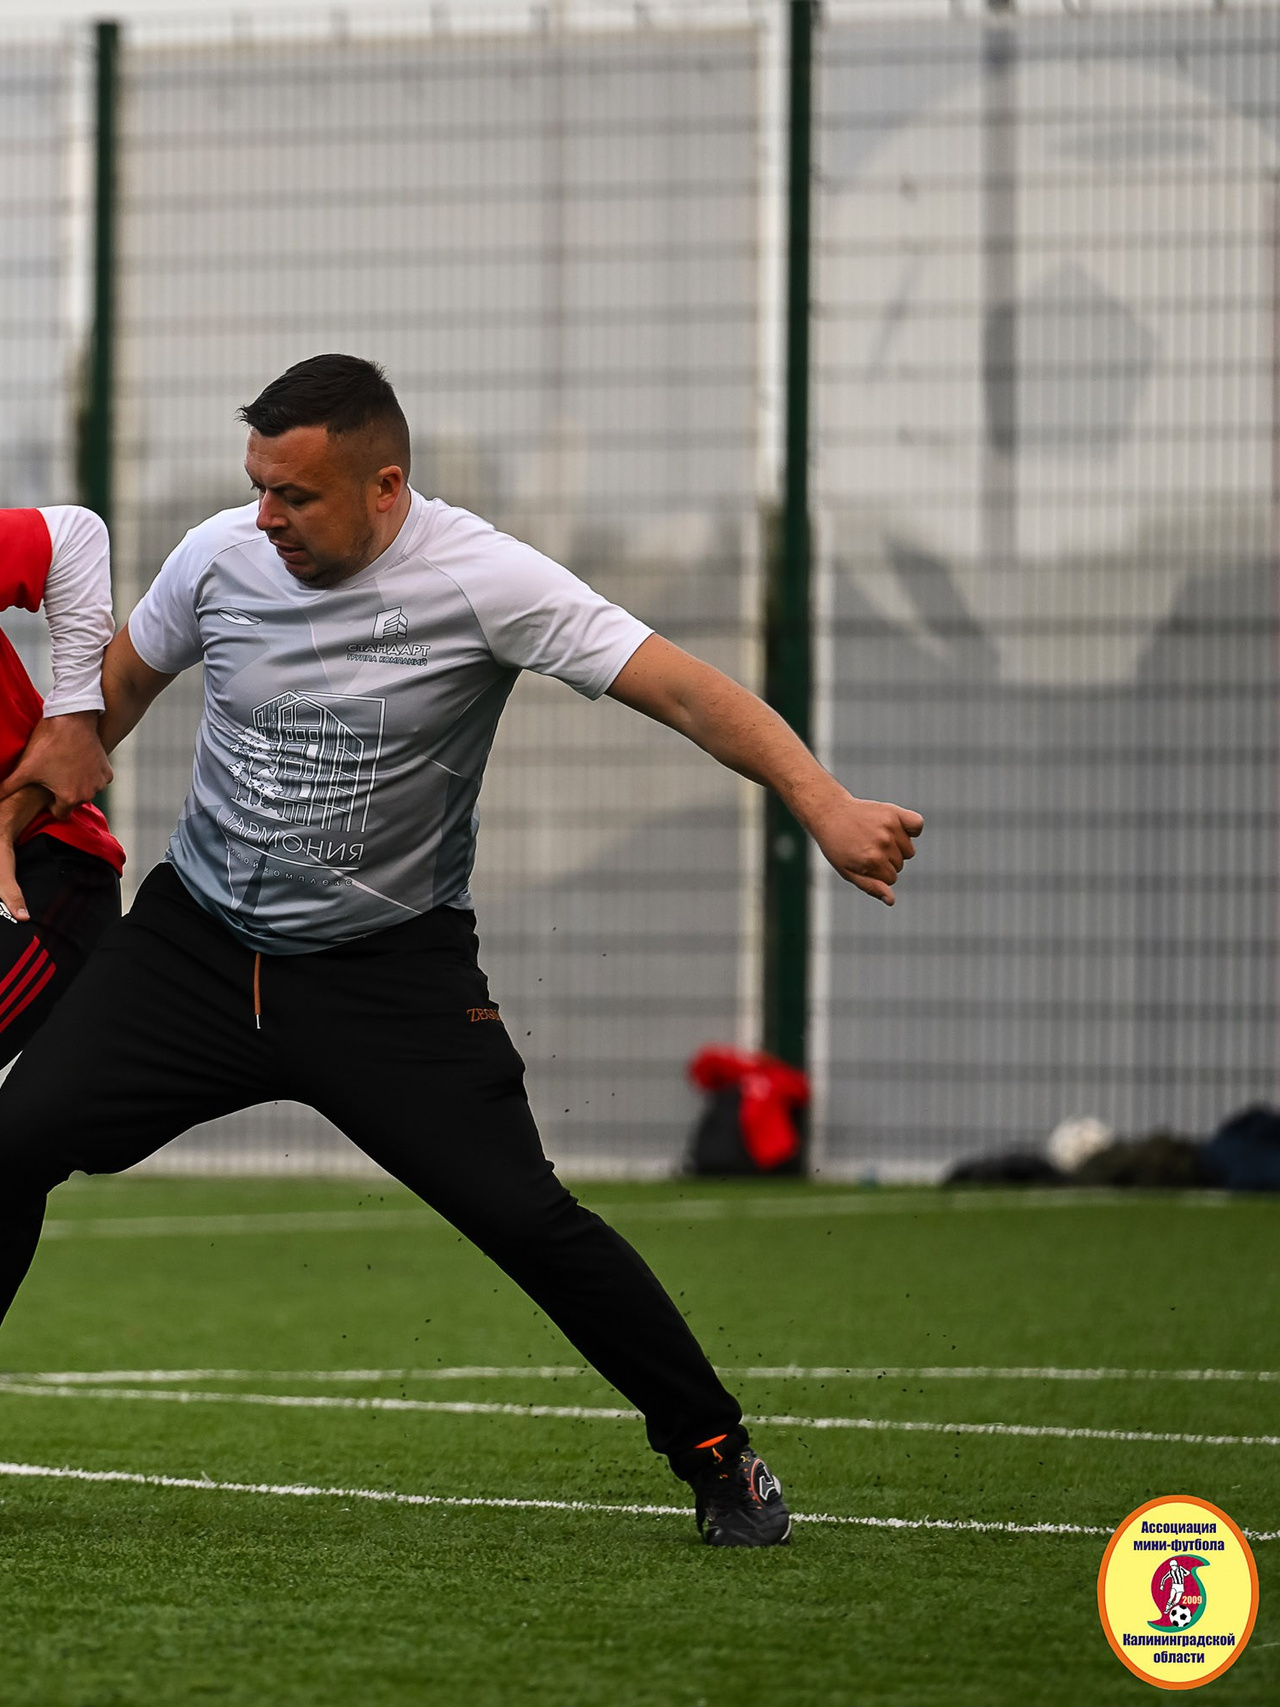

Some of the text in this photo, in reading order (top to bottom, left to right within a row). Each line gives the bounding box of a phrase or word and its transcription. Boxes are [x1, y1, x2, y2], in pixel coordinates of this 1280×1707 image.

[346, 643, 431, 658] СТАНДАРТ
[378, 655, 428, 667] КОМПАНИЙ
[223, 811, 365, 861] ГАРМОНИЯ
